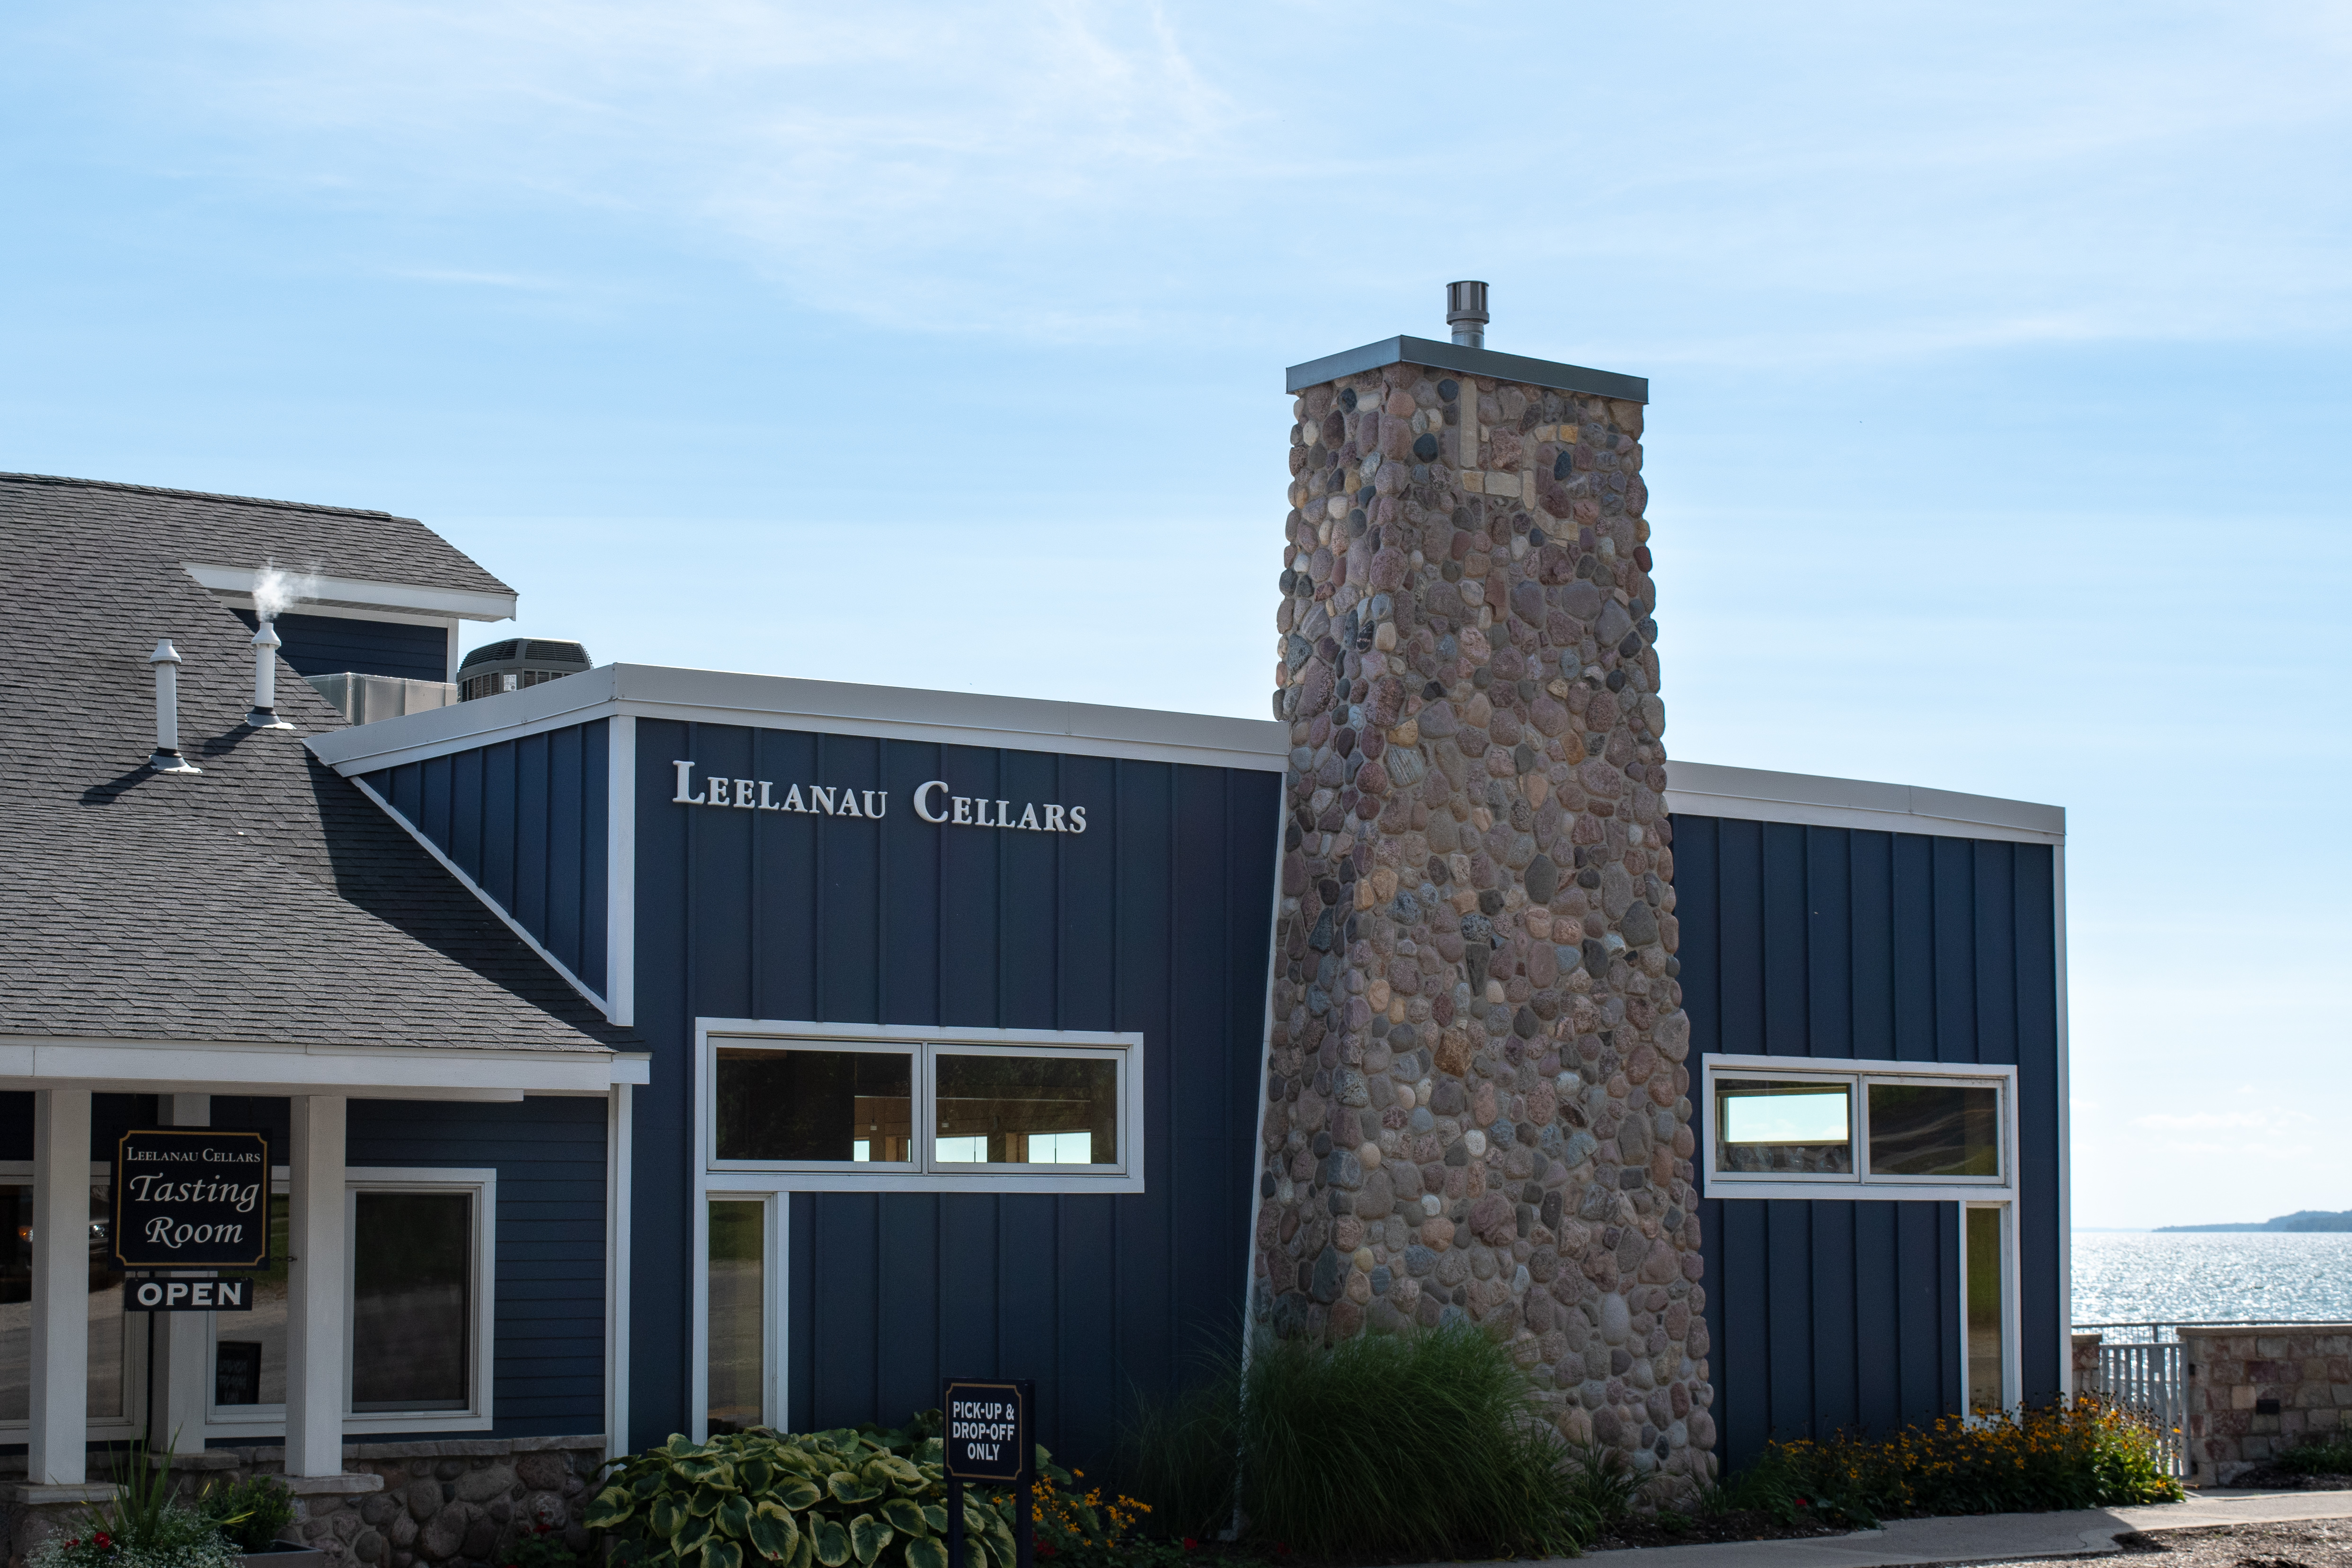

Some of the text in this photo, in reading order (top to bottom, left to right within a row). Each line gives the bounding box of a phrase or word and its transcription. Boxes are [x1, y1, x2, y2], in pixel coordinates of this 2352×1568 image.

[672, 760, 1087, 833] LEELANAU CELLARS
[126, 1147, 261, 1163] LEELANAU CELLARS
[129, 1172, 260, 1213] Tasting
[145, 1216, 243, 1249] Room
[137, 1282, 242, 1306] OPEN
[953, 1401, 1014, 1420] PICK-UP &
[953, 1421, 1015, 1441] DROP-OFF
[967, 1443, 1000, 1461] ONLY
